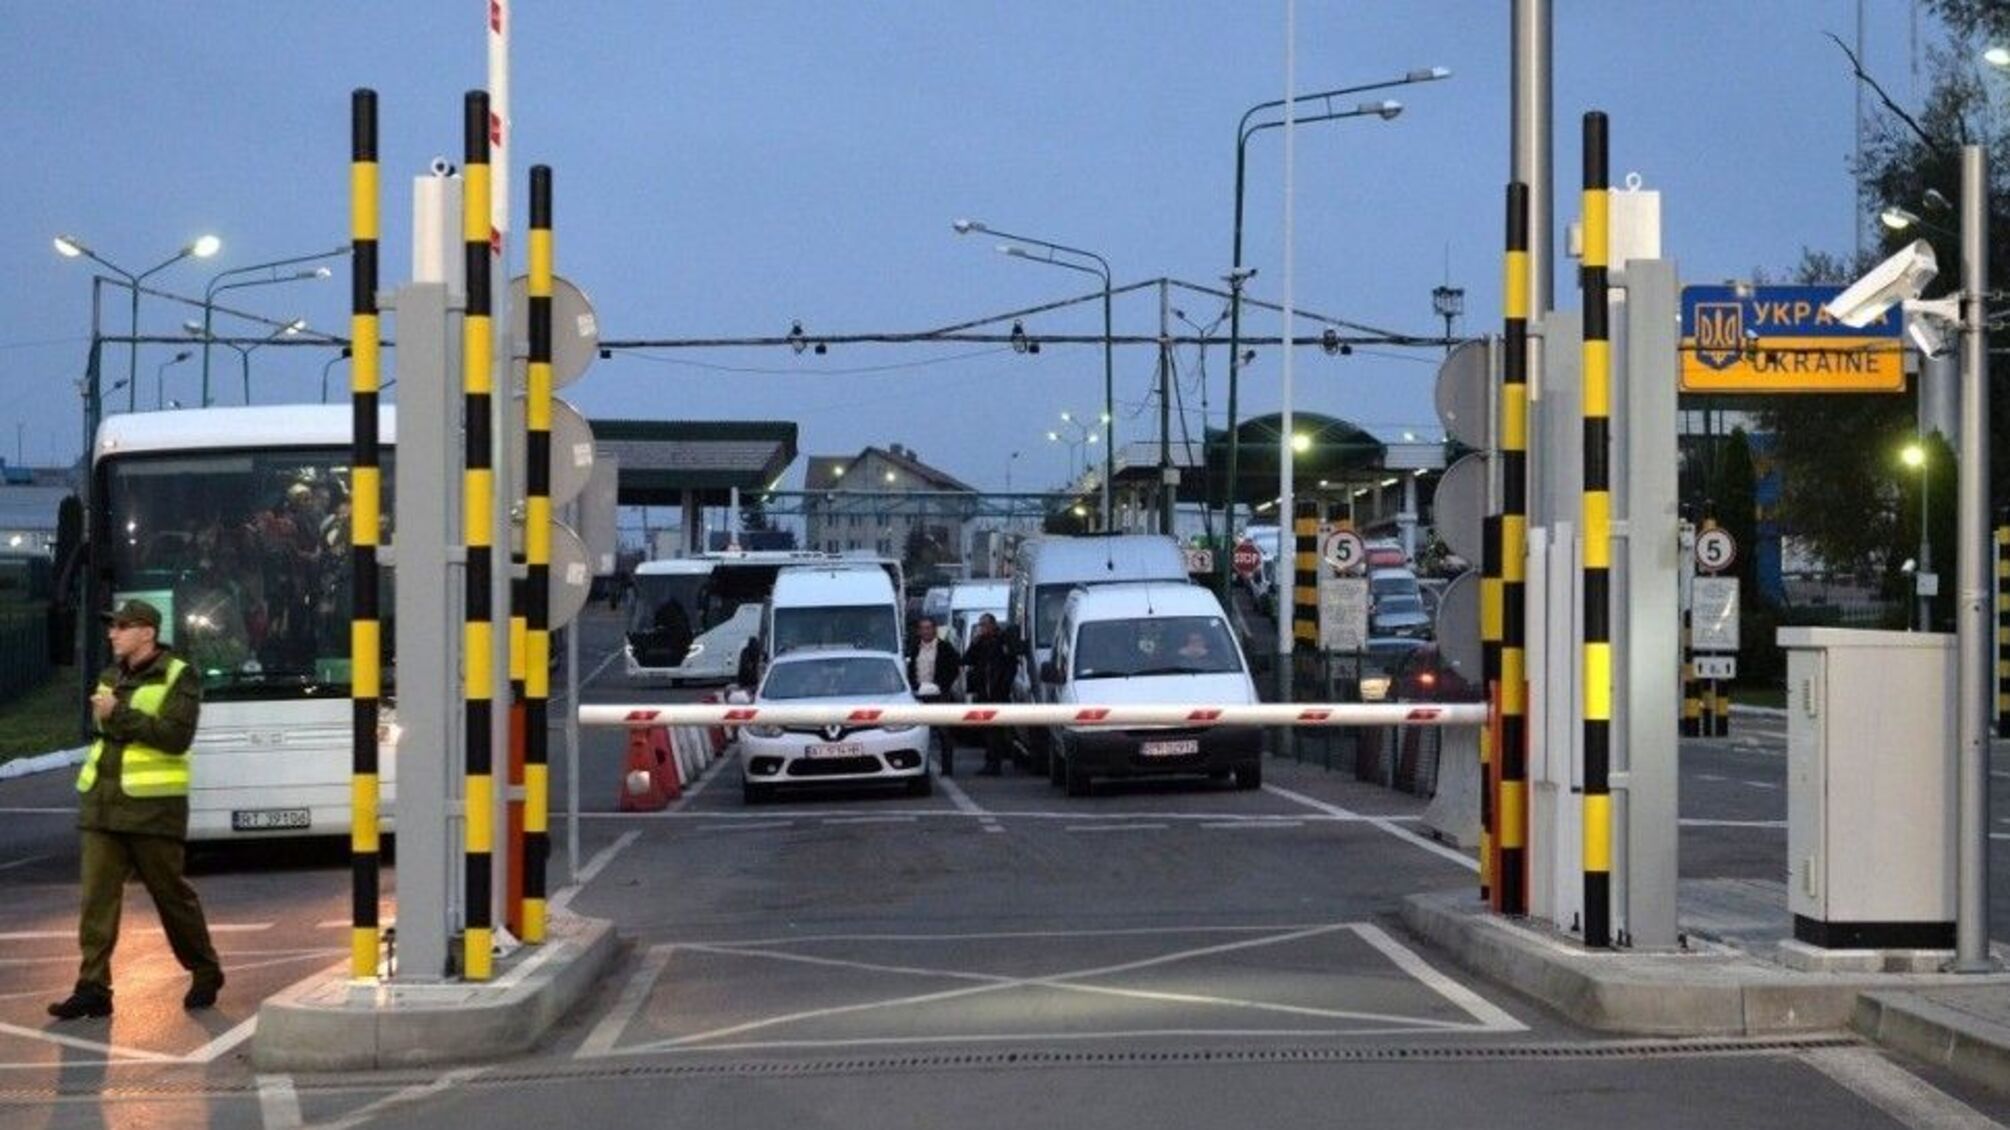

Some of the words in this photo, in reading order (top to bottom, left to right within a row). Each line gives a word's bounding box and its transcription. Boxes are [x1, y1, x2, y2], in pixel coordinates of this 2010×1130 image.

[1754, 349, 1880, 373] UKRAINE
[1234, 552, 1258, 565] STOP
[1336, 539, 1351, 561] 5
[1707, 539, 1721, 561] 5
